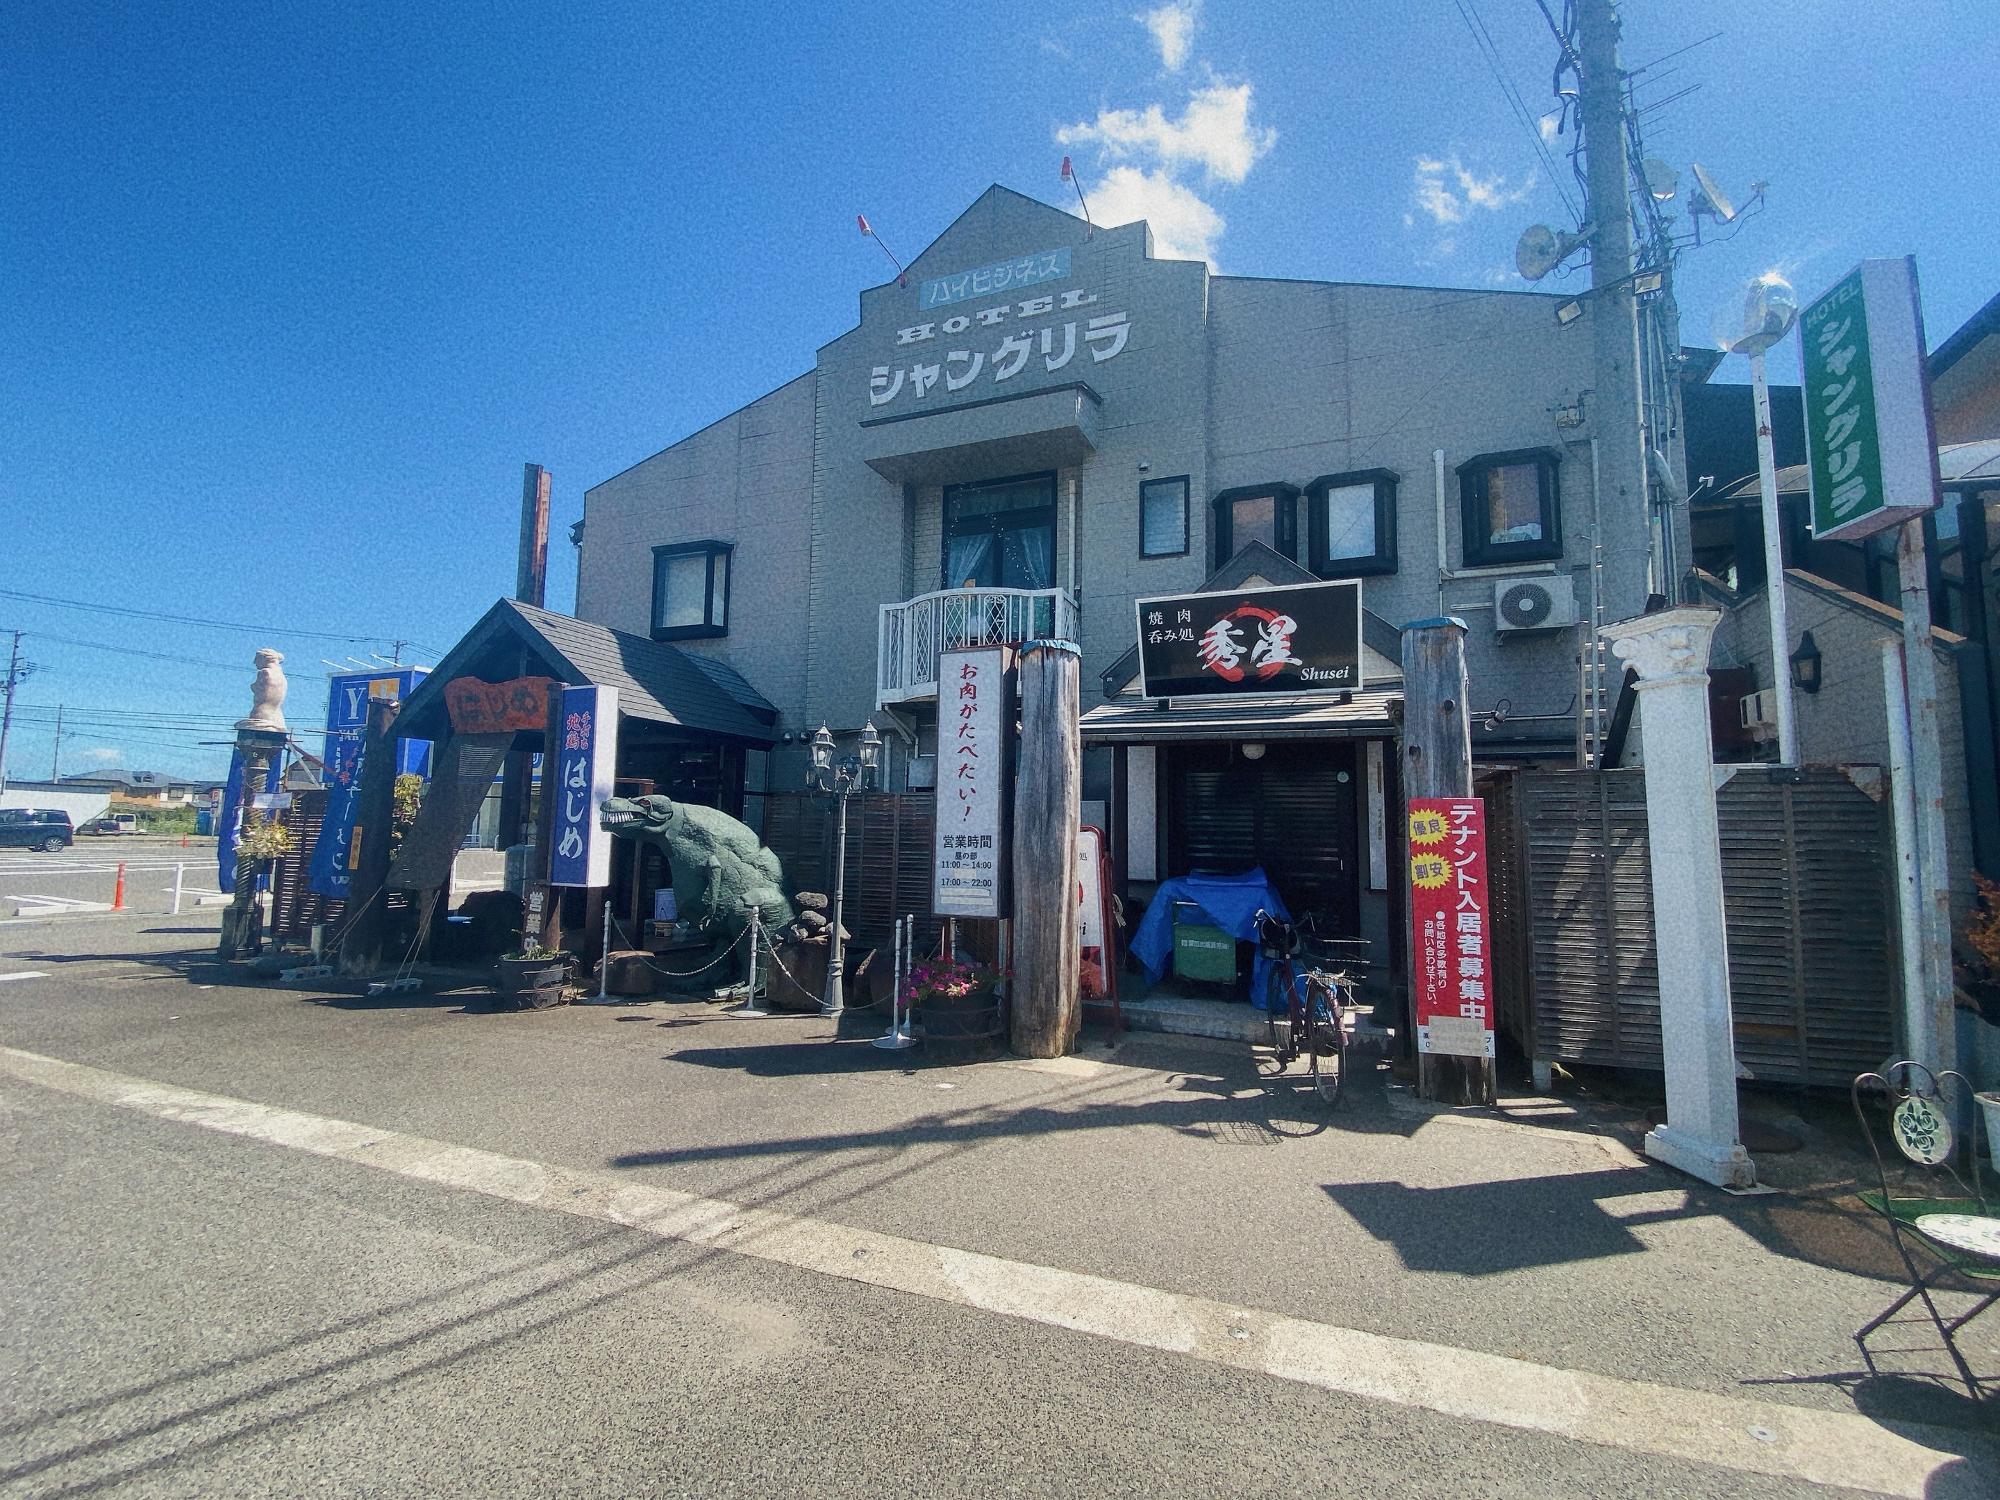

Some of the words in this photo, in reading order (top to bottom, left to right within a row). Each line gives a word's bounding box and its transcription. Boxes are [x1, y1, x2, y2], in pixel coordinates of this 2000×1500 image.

[928, 253, 1060, 305] ハイビジネス
[896, 288, 1098, 345] HOTEL
[1806, 281, 1861, 329] HOTEL
[869, 311, 1132, 407] シャングリラ
[1817, 315, 1867, 519] シャングリラ
[1147, 628, 1194, 645] 呑み処
[1300, 665, 1350, 681] Shusei
[558, 756, 588, 859] はじめ
[1413, 818, 1442, 836] 優良
[943, 834, 992, 849] 営業時間
[1414, 861, 1444, 880] 割安
[1449, 804, 1486, 1020] テナント入居者募集中
